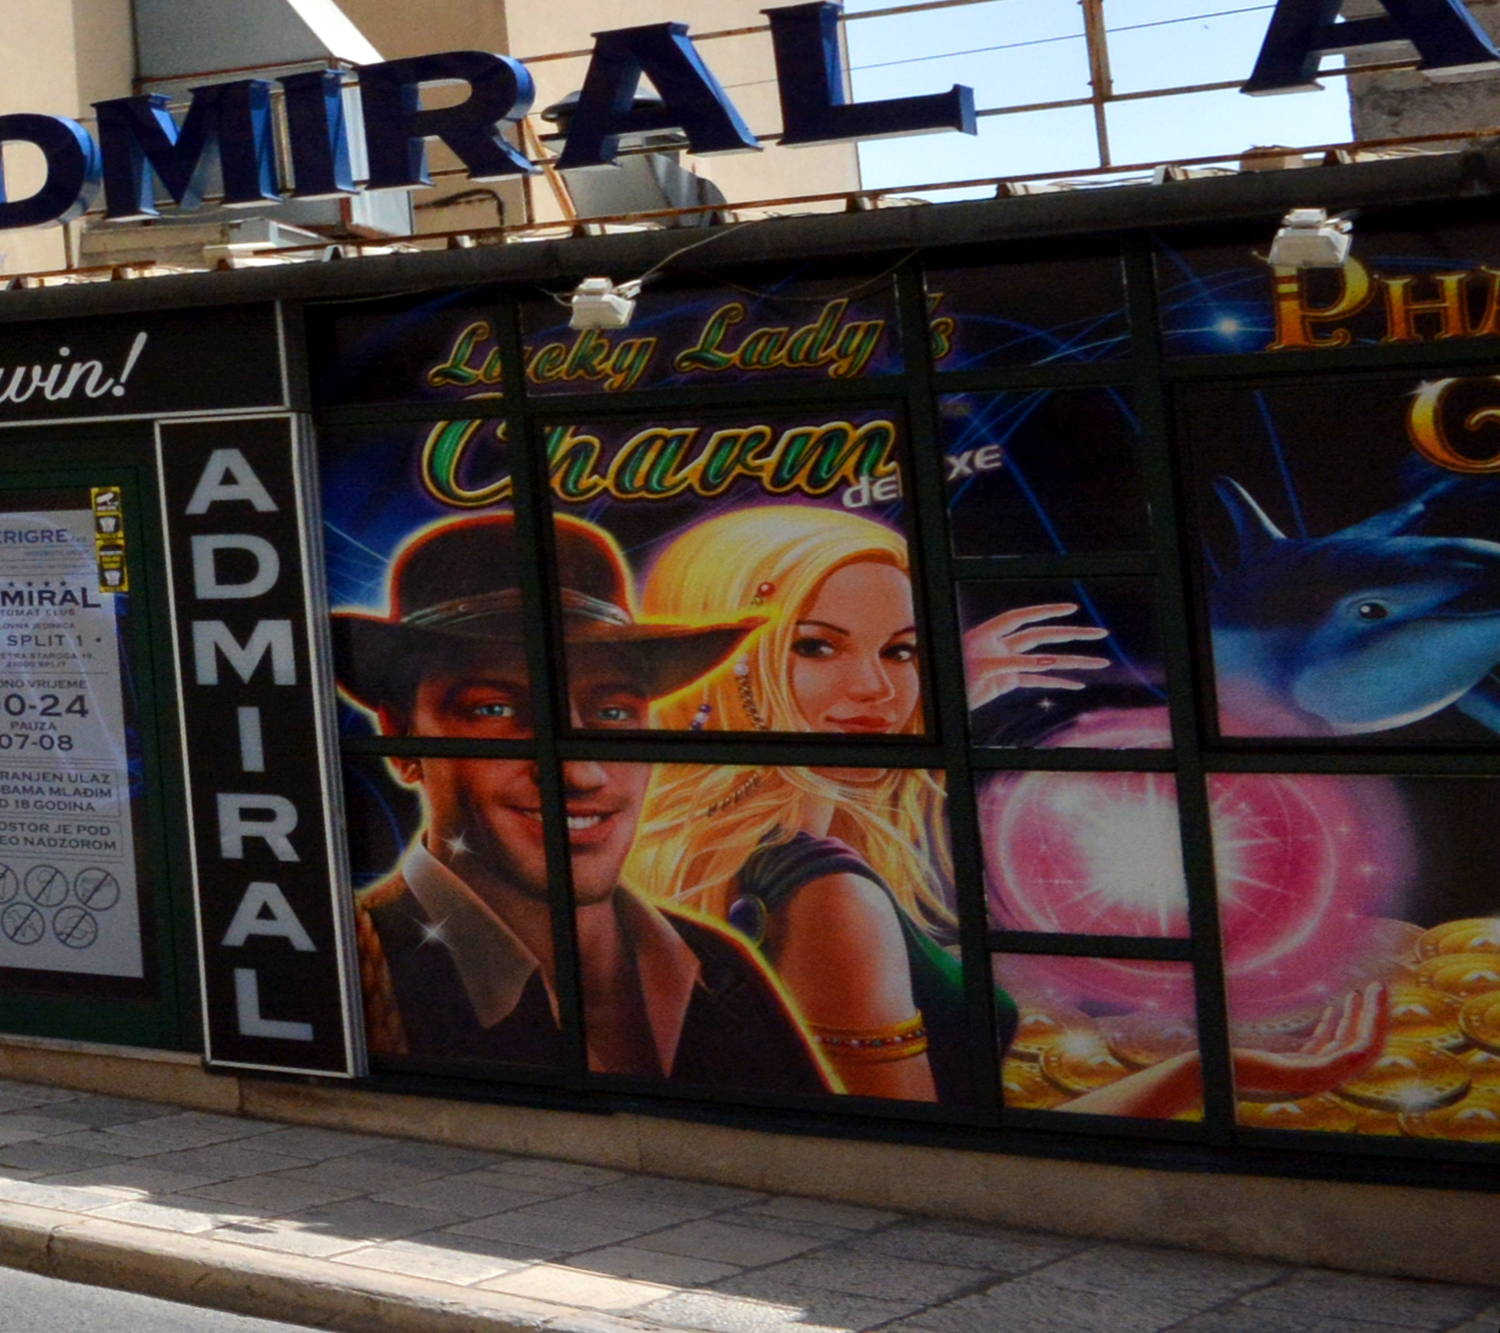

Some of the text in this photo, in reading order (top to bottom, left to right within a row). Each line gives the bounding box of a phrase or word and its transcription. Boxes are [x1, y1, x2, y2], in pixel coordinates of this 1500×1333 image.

[426, 320, 658, 393] Lucky
[420, 391, 901, 508] Charm
[7, 635, 65, 646] SPLIT
[77, 635, 83, 647] 1
[29, 679, 87, 689] VRIJEME
[10, 721, 57, 731] PAUZA
[185, 448, 317, 1042] ADMIRAL
[67, 772, 111, 784] ULAZ
[14, 799, 30, 809] 18
[33, 800, 96, 813] GODINA
[54, 824, 72, 834] JE
[77, 824, 111, 836] POD
[24, 836, 116, 850] NADZOROM
